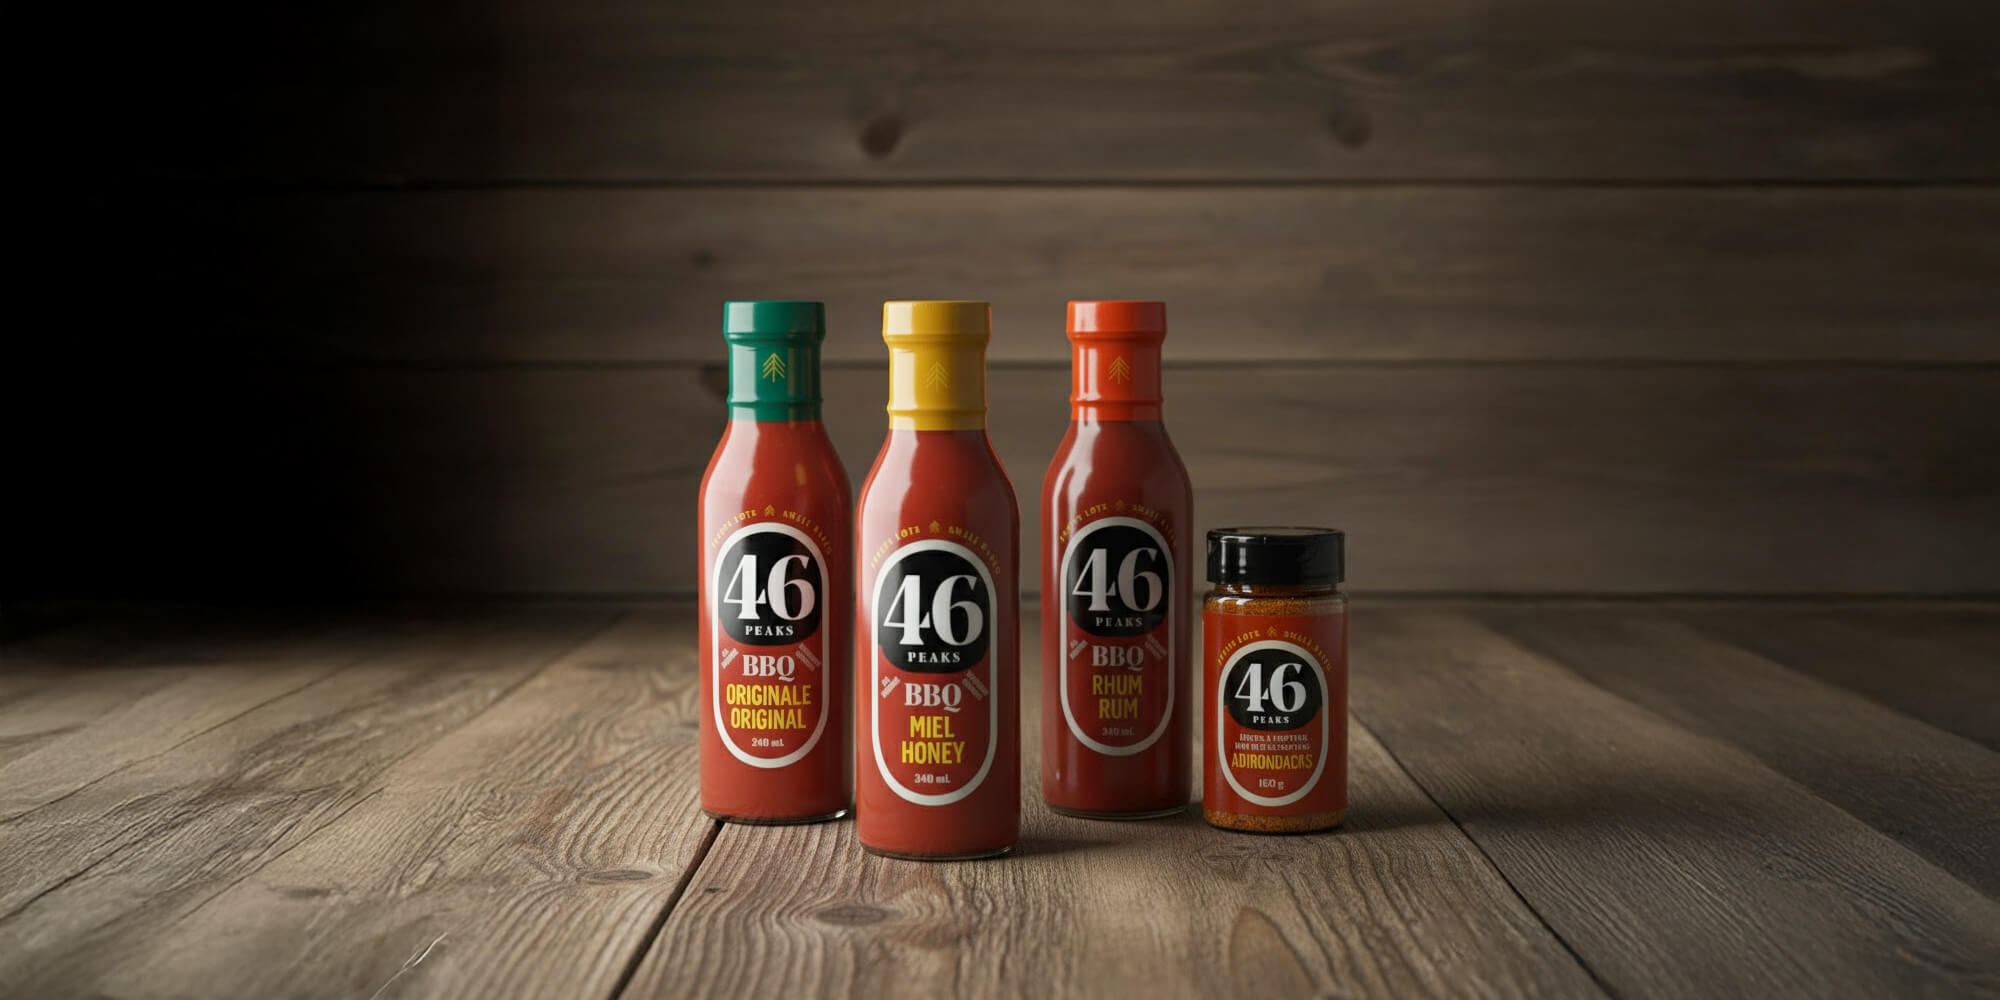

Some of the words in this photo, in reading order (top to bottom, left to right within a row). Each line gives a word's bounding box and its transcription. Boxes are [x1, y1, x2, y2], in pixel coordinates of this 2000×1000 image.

[723, 554, 816, 621] 46
[1071, 547, 1163, 612] 46
[883, 574, 984, 646] 46
[745, 625, 794, 636] PEAKS
[1095, 617, 1144, 628] PEAKS
[742, 654, 796, 682] BBQ
[907, 651, 961, 663] PEAKS
[1091, 645, 1144, 671] BBQ
[726, 683, 812, 706] ORIGINALE
[1092, 674, 1143, 696] RHUM
[1234, 662, 1307, 713] 46
[904, 682, 962, 713] BBQ
[1099, 698, 1139, 719] RUM
[731, 707, 807, 730] ORIGINAL
[910, 715, 956, 738] MIEL
[1252, 715, 1290, 725] PEAKS
[901, 740, 965, 765] HONEY
[914, 773, 934, 784] 340
